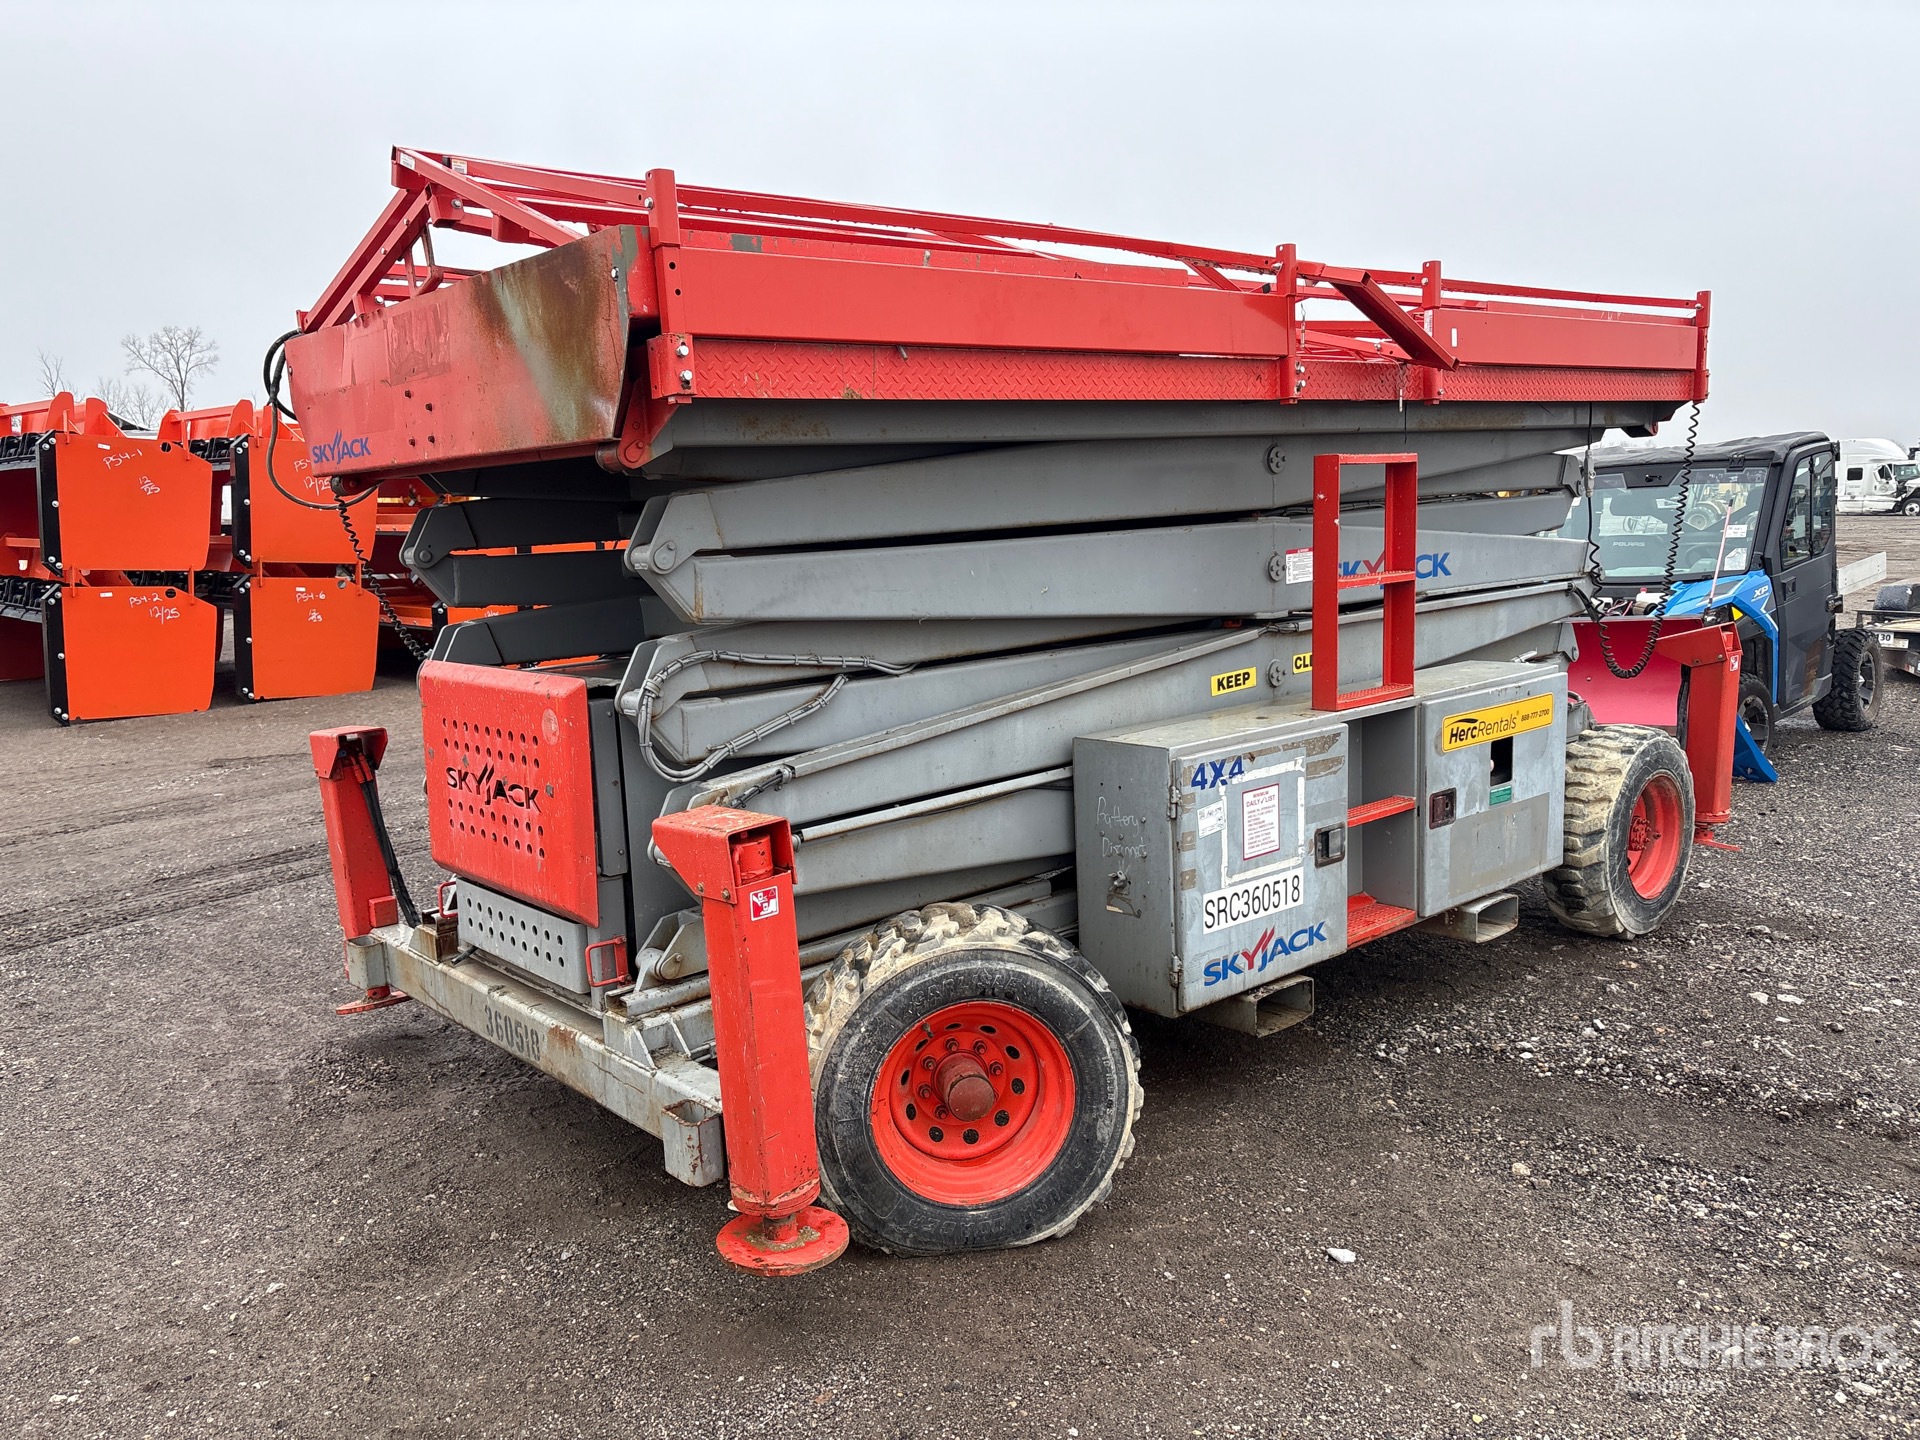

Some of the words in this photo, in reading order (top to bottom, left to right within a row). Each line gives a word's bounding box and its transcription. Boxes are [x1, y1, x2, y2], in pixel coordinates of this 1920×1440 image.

[312, 429, 371, 465] SKYJACK
[1753, 585, 1769, 598] XP
[149, 606, 181, 625] 12/25
[1217, 671, 1250, 692] KEEP
[1294, 654, 1312, 670] CL
[1521, 708, 1550, 721] 888-777-2700
[446, 762, 542, 813] SKYJACK
[1190, 754, 1245, 791] 4X4
[1204, 874, 1301, 929] SRC360518
[1203, 921, 1327, 987] SKYJACK
[484, 1004, 541, 1062] 360518
